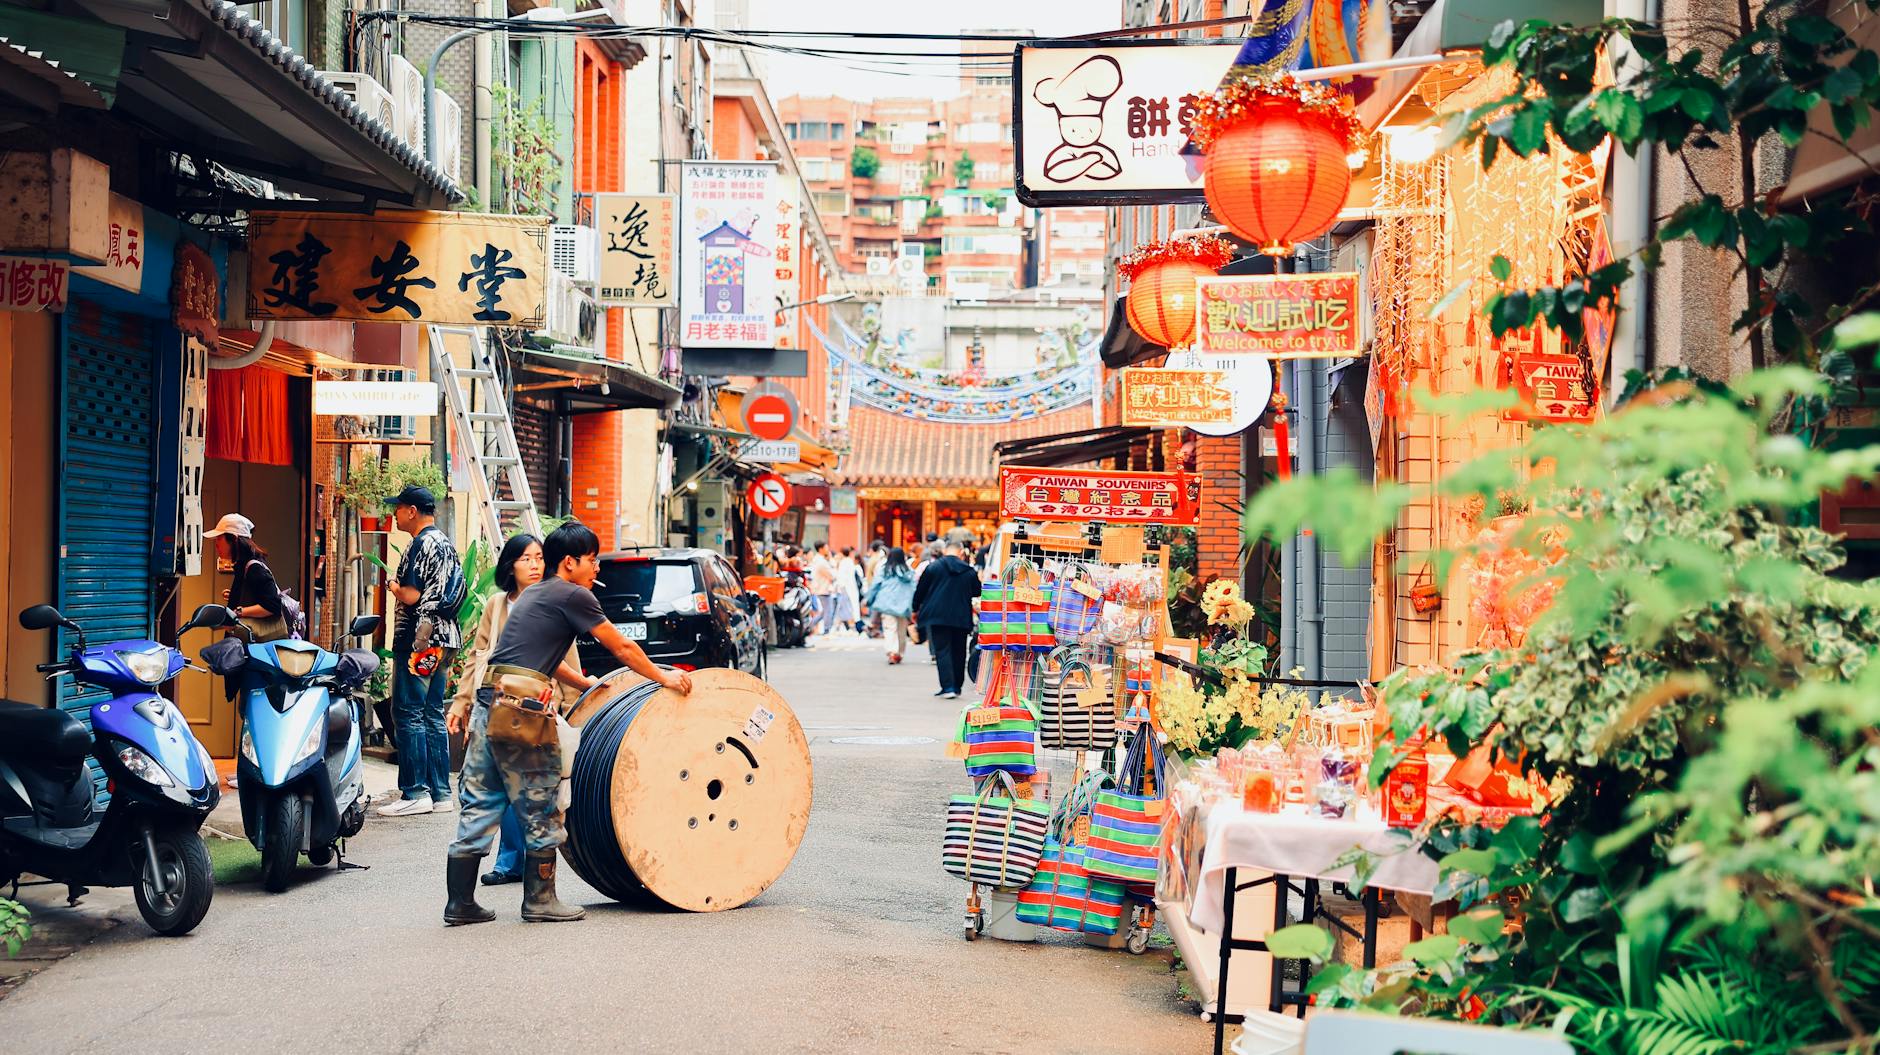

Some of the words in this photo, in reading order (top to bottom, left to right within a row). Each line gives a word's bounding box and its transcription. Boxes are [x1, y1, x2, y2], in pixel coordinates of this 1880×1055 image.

[264, 232, 526, 321] 建安堂
[1206, 280, 1349, 298] ぜひお試しください
[1206, 298, 1349, 334] 歡迎試吃
[1209, 334, 1283, 349] Welcome
[1288, 336, 1305, 349] to
[1310, 335, 1331, 352] try
[1336, 333, 1348, 348] it
[1545, 365, 1580, 378] TAIW
[1038, 476, 1088, 488] TAIWAN
[1096, 479, 1166, 490] SOUVENIRS
[1029, 487, 1172, 507] 台灣紀念品
[1038, 504, 1166, 518] 台湾のお土産
